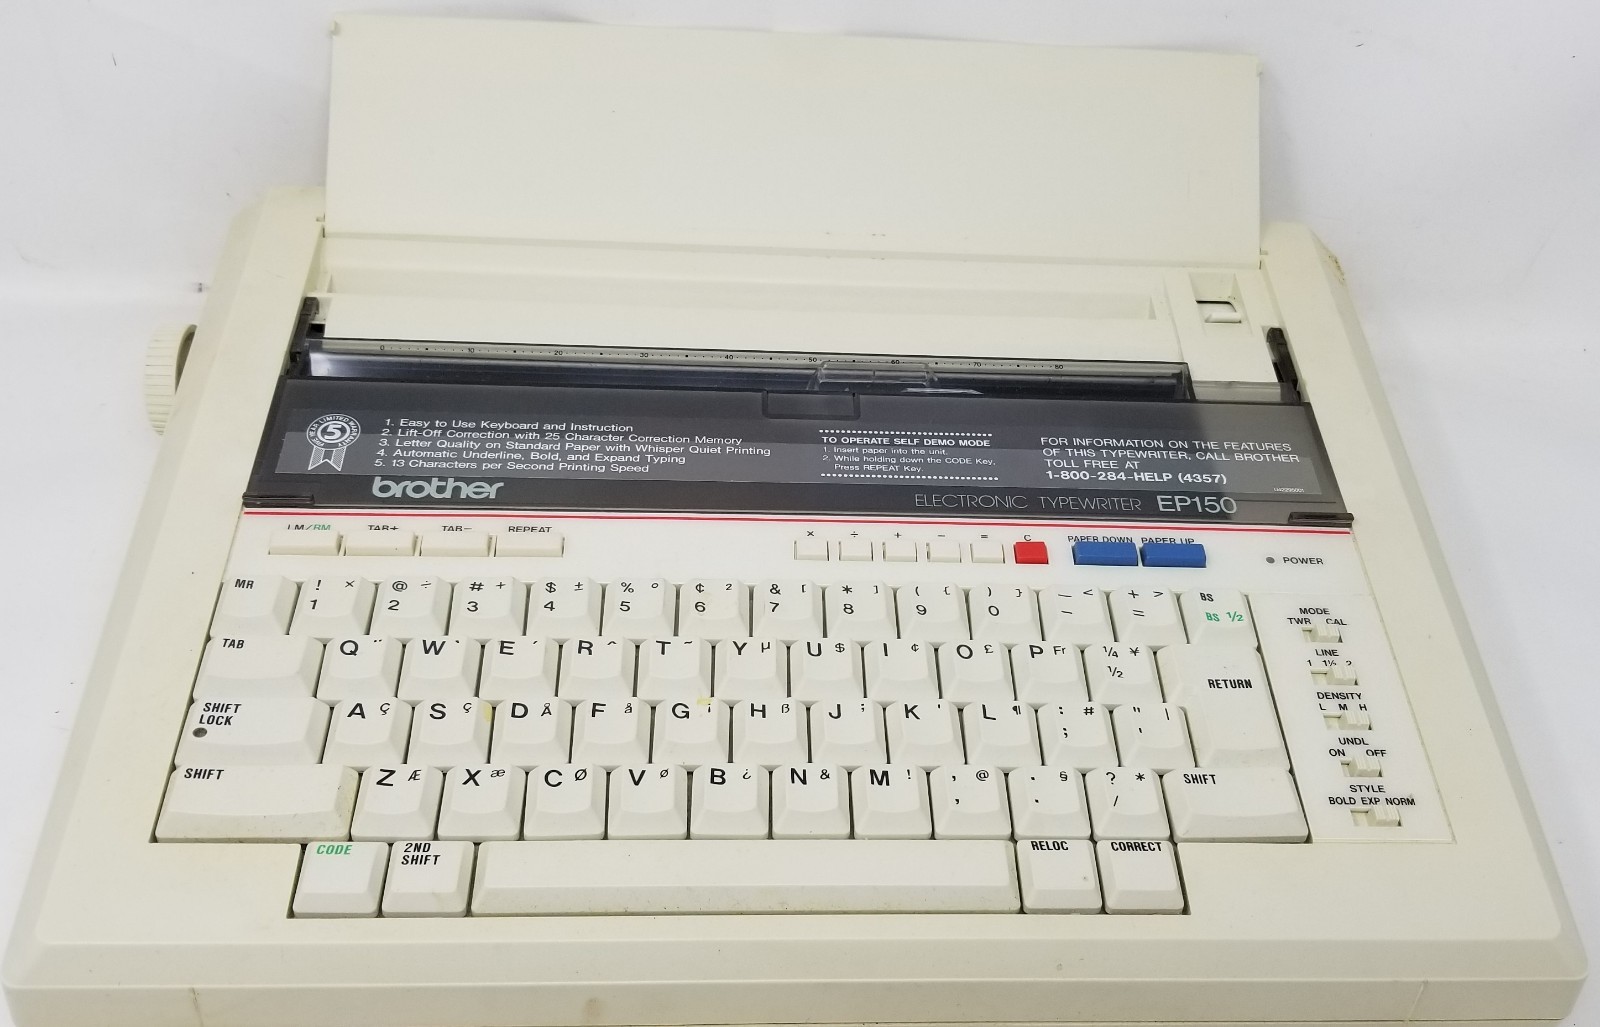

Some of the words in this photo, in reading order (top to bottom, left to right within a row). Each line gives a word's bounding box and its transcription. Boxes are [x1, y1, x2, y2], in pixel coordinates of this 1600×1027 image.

[385, 419, 394, 427] 1.
[400, 419, 430, 428] Easy
[452, 420, 476, 428] Use
[481, 421, 539, 430] Keyboard
[543, 423, 566, 431] and
[571, 423, 633, 432] Instruction
[324, 424, 342, 440] 5
[381, 428, 392, 436] 2.
[398, 429, 442, 438] Lift-Off
[447, 430, 512, 439] Correction
[515, 432, 540, 440] with
[565, 433, 624, 442] Character
[629, 434, 690, 443] Correction
[695, 436, 742, 445] Memory
[841, 437, 890, 445] OPERATE
[923, 438, 955, 446] DEMO
[958, 439, 991, 447] MODE
[1040, 437, 1068, 446] FOR
[1072, 438, 1164, 448] INFORMATION
[1168, 440, 1188, 449] ON
[1192, 440, 1220, 450] THE
[1223, 441, 1292, 452] FEATURES
[395, 439, 432, 448] Letter
[437, 440, 480, 450] Quality
[506, 442, 561, 451] Standard
[566, 443, 601, 452] Paper
[606, 444, 630, 452] with
[635, 445, 685, 454] Whisper
[689, 445, 721, 454] Quiet
[726, 446, 771, 456] Printing
[376, 449, 388, 457] 4.
[393, 449, 457, 458] Automatic
[462, 451, 525, 461] Underline,
[530, 452, 562, 461] Bold,
[567, 453, 590, 461] and
[595, 454, 640, 463] Expand
[645, 454, 685, 464] Typing
[1043, 448, 1060, 457] OF
[1065, 448, 1096, 458] THIS
[1100, 450, 1191, 460] TYPEWRITER,
[1196, 452, 1230, 461] CALL
[1235, 452, 1300, 463] BROTHER
[374, 459, 385, 467] 5.
[392, 459, 405, 467] 13
[409, 460, 477, 469] Characters
[482, 462, 502, 471] per
[507, 462, 555, 470] Second
[559, 463, 605, 472] Printing
[610, 464, 649, 473] Speed
[863, 456, 896, 464] holding
[975, 458, 996, 466] Key,
[1044, 459, 1079, 468] TOLL
[1084, 460, 1119, 469] FREE
[1125, 460, 1140, 469] AT
[903, 465, 924, 473] Key.
[1046, 471, 1172, 482] 1-800-284-HELP
[1178, 472, 1227, 485] (4357)
[372, 476, 504, 499] brother
[914, 494, 1028, 509] ELECTRONIC
[1038, 496, 1142, 512] TYPEWRITER
[1156, 495, 1237, 514] EP150
[1283, 556, 1324, 565] POWER
[235, 579, 254, 589] MR
[1200, 593, 1213, 602] BS
[388, 600, 399, 610] 2
[544, 601, 555, 611] 4
[695, 602, 705, 612] 6
[844, 604, 854, 614] 8
[1206, 612, 1219, 621] BS
[1326, 618, 1347, 626] CAL
[223, 639, 244, 648] TAB
[340, 640, 358, 656] Q
[500, 641, 515, 655] E
[656, 641, 670, 655] T
[807, 642, 822, 656] U
[1029, 645, 1043, 658] P
[1315, 648, 1339, 657] LINE
[1208, 679, 1252, 688] RETURN
[1317, 692, 1362, 700] DENSITY
[202, 703, 241, 713] SHIFT
[347, 703, 365, 718] A
[511, 703, 528, 718] D
[672, 703, 689, 719] G
[829, 704, 841, 719] J
[982, 704, 996, 720] L
[1319, 703, 1326, 711] L
[1338, 703, 1348, 711] M
[1359, 703, 1368, 711] H
[199, 714, 233, 725] LOCK
[1338, 737, 1369, 746] UNDL
[1329, 748, 1346, 757] ON
[1366, 749, 1387, 757] OFF
[184, 768, 224, 779] SHIFT
[376, 769, 392, 786] Z
[545, 770, 562, 787] C
[710, 768, 726, 785] B
[870, 769, 889, 786] M
[1184, 774, 1215, 784] SHIFT
[1349, 784, 1386, 793] STYLE
[1328, 796, 1356, 805] BOLD
[1361, 797, 1381, 806] EXP
[1385, 797, 1416, 806] NORM
[317, 845, 352, 854] CODE
[404, 843, 431, 852] 2ND
[1031, 841, 1068, 850] RELOC
[1111, 842, 1161, 851] CORRECT
[401, 855, 440, 865] SHIFT
